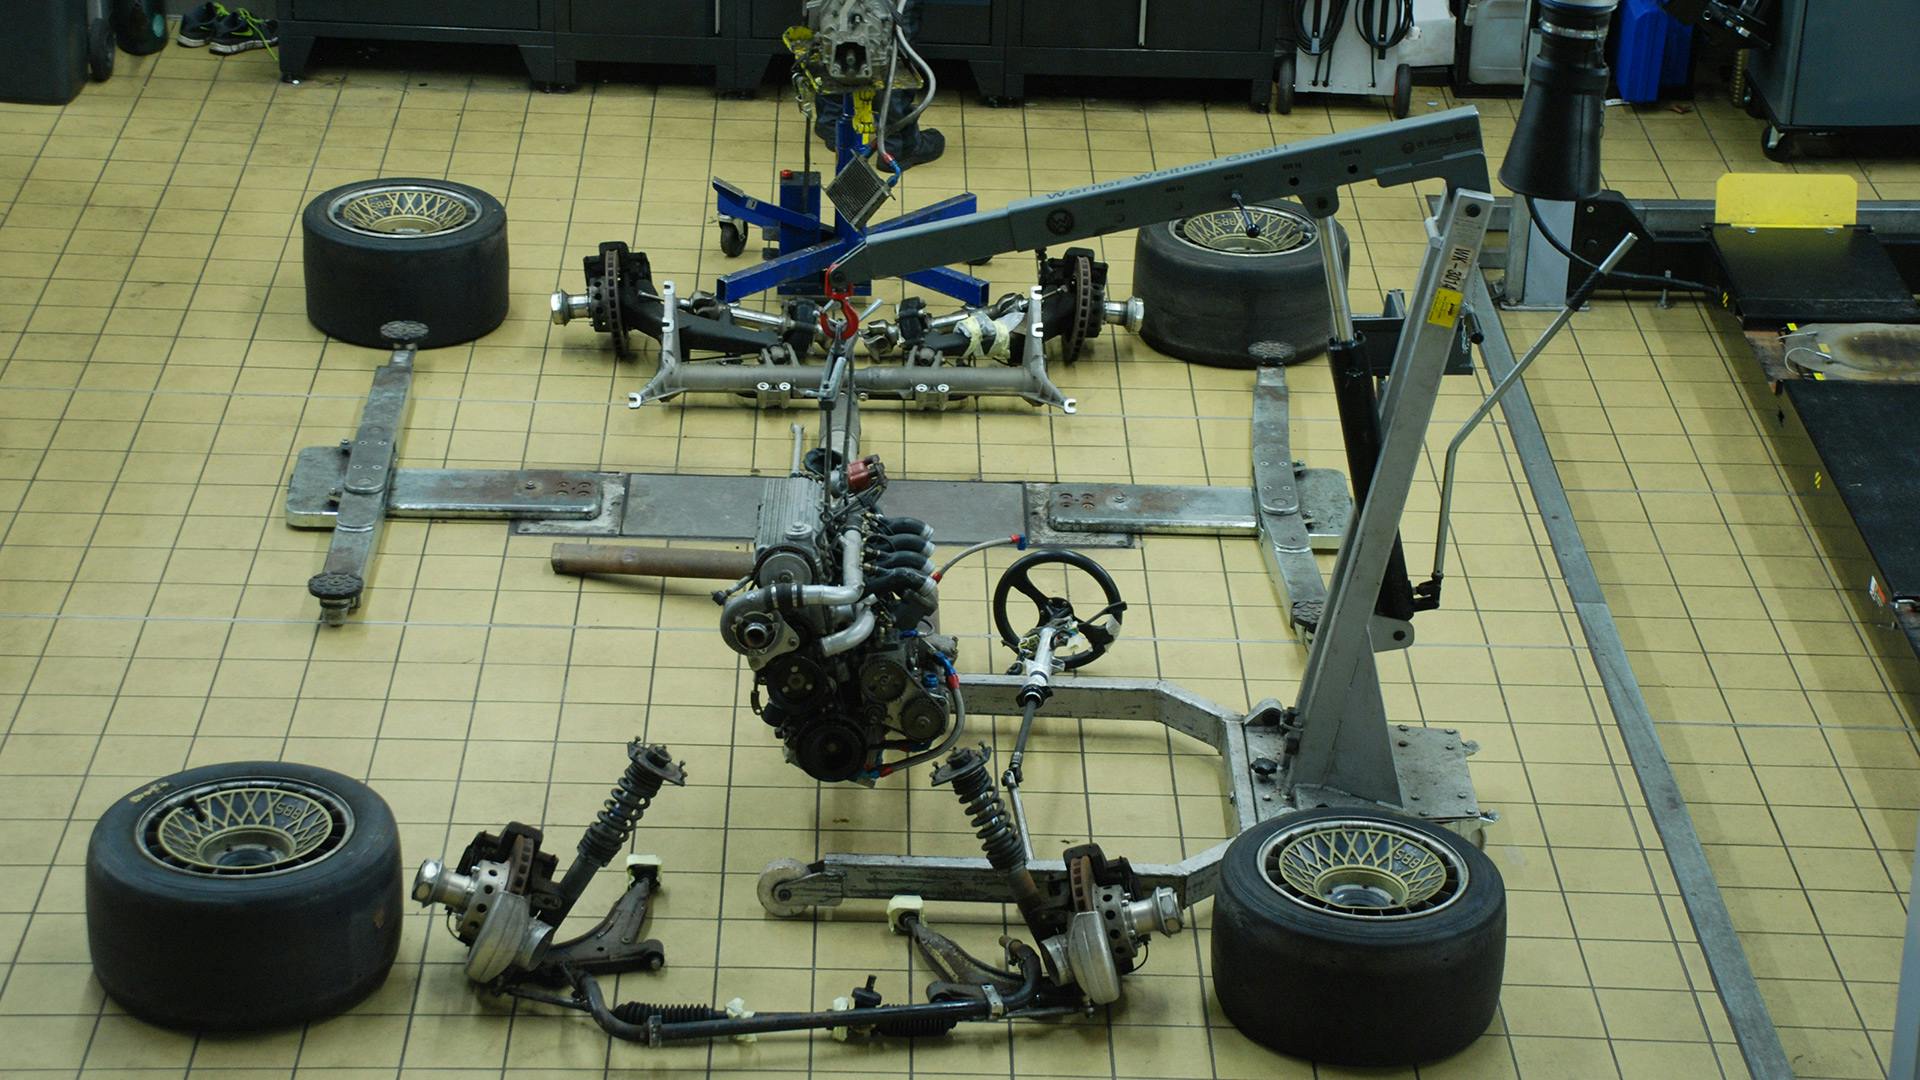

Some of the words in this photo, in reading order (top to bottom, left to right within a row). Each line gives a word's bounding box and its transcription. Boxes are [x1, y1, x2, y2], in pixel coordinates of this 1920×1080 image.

[1225, 144, 1289, 162] GmbH
[274, 802, 303, 820] BBS
[1394, 848, 1421, 869] BBS
